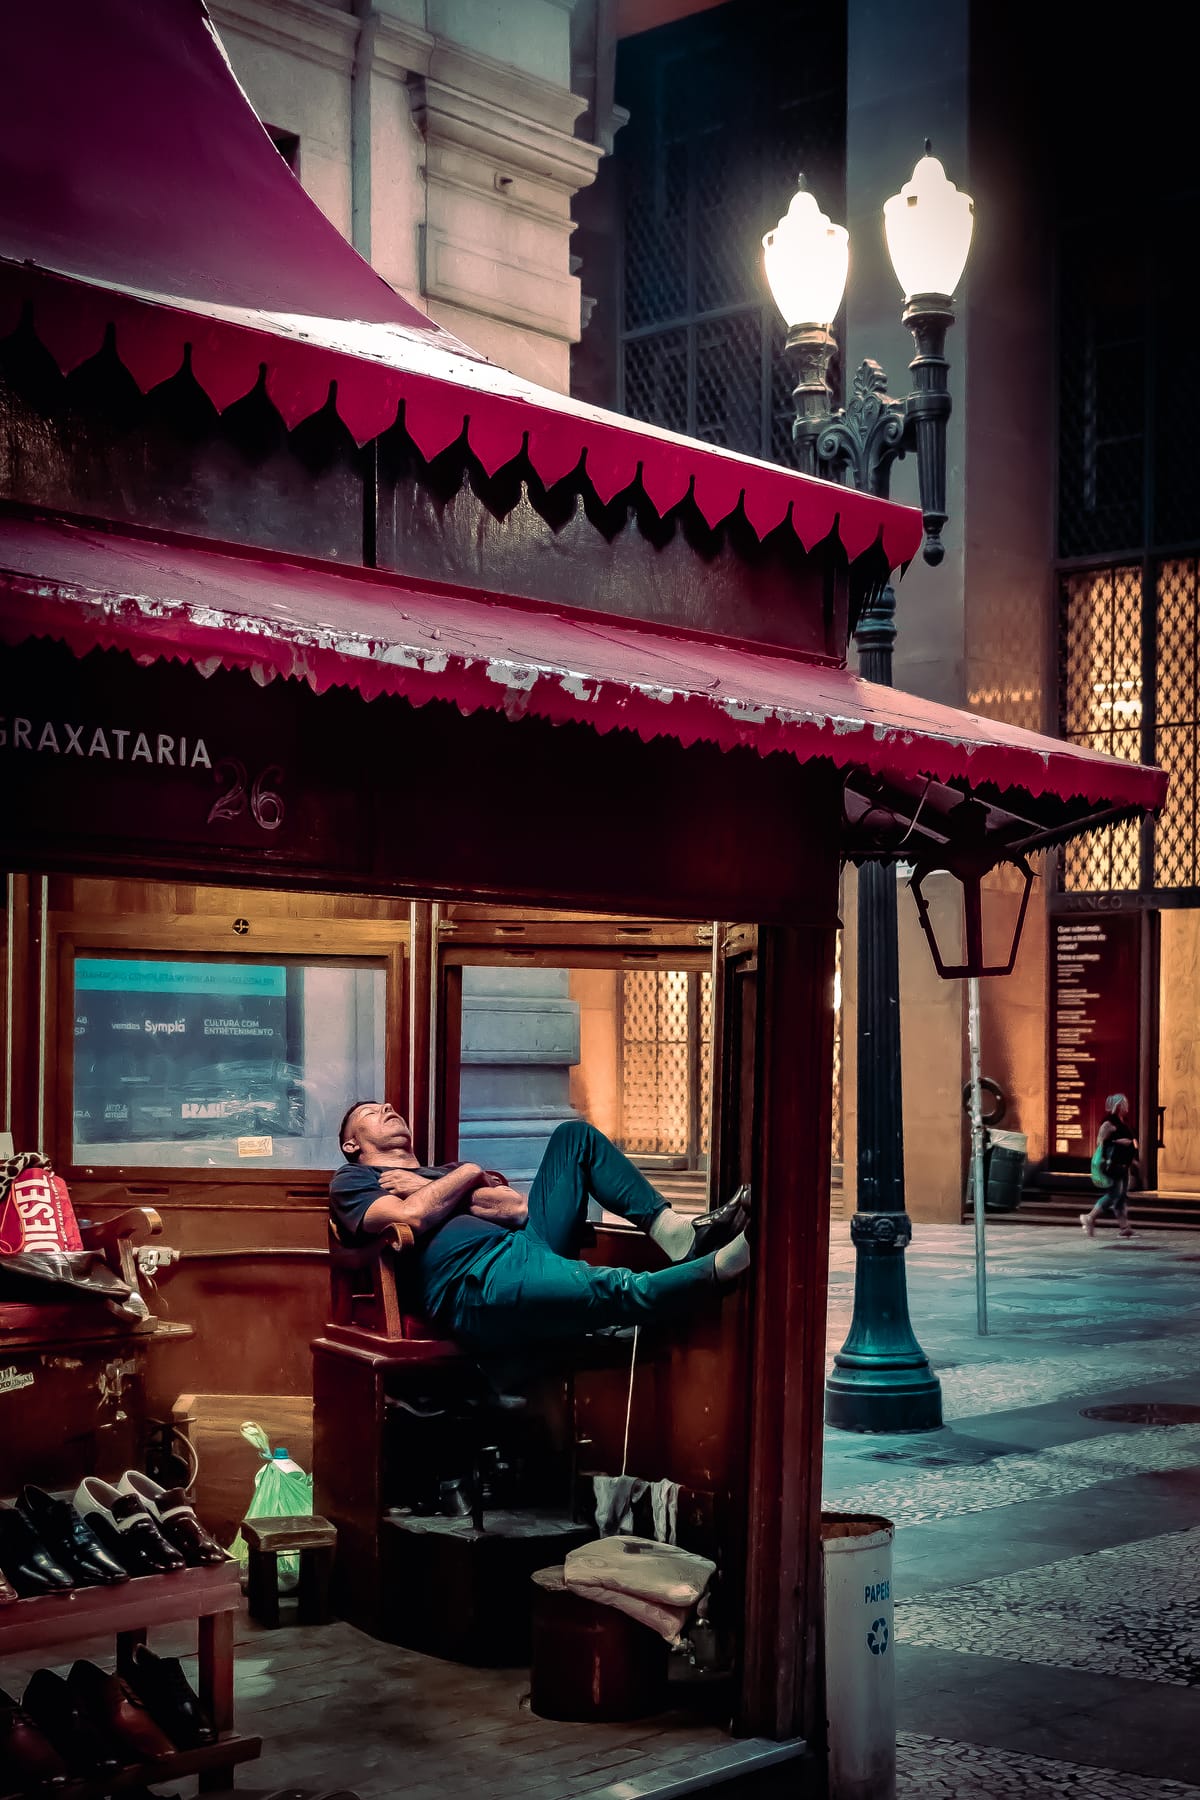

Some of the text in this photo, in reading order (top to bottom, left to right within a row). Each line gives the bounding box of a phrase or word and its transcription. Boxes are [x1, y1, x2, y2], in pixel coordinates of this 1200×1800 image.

[207, 757, 286, 830] 26
[203, 1019, 240, 1028] CULTURA
[14, 1174, 62, 1253] DIESEL
